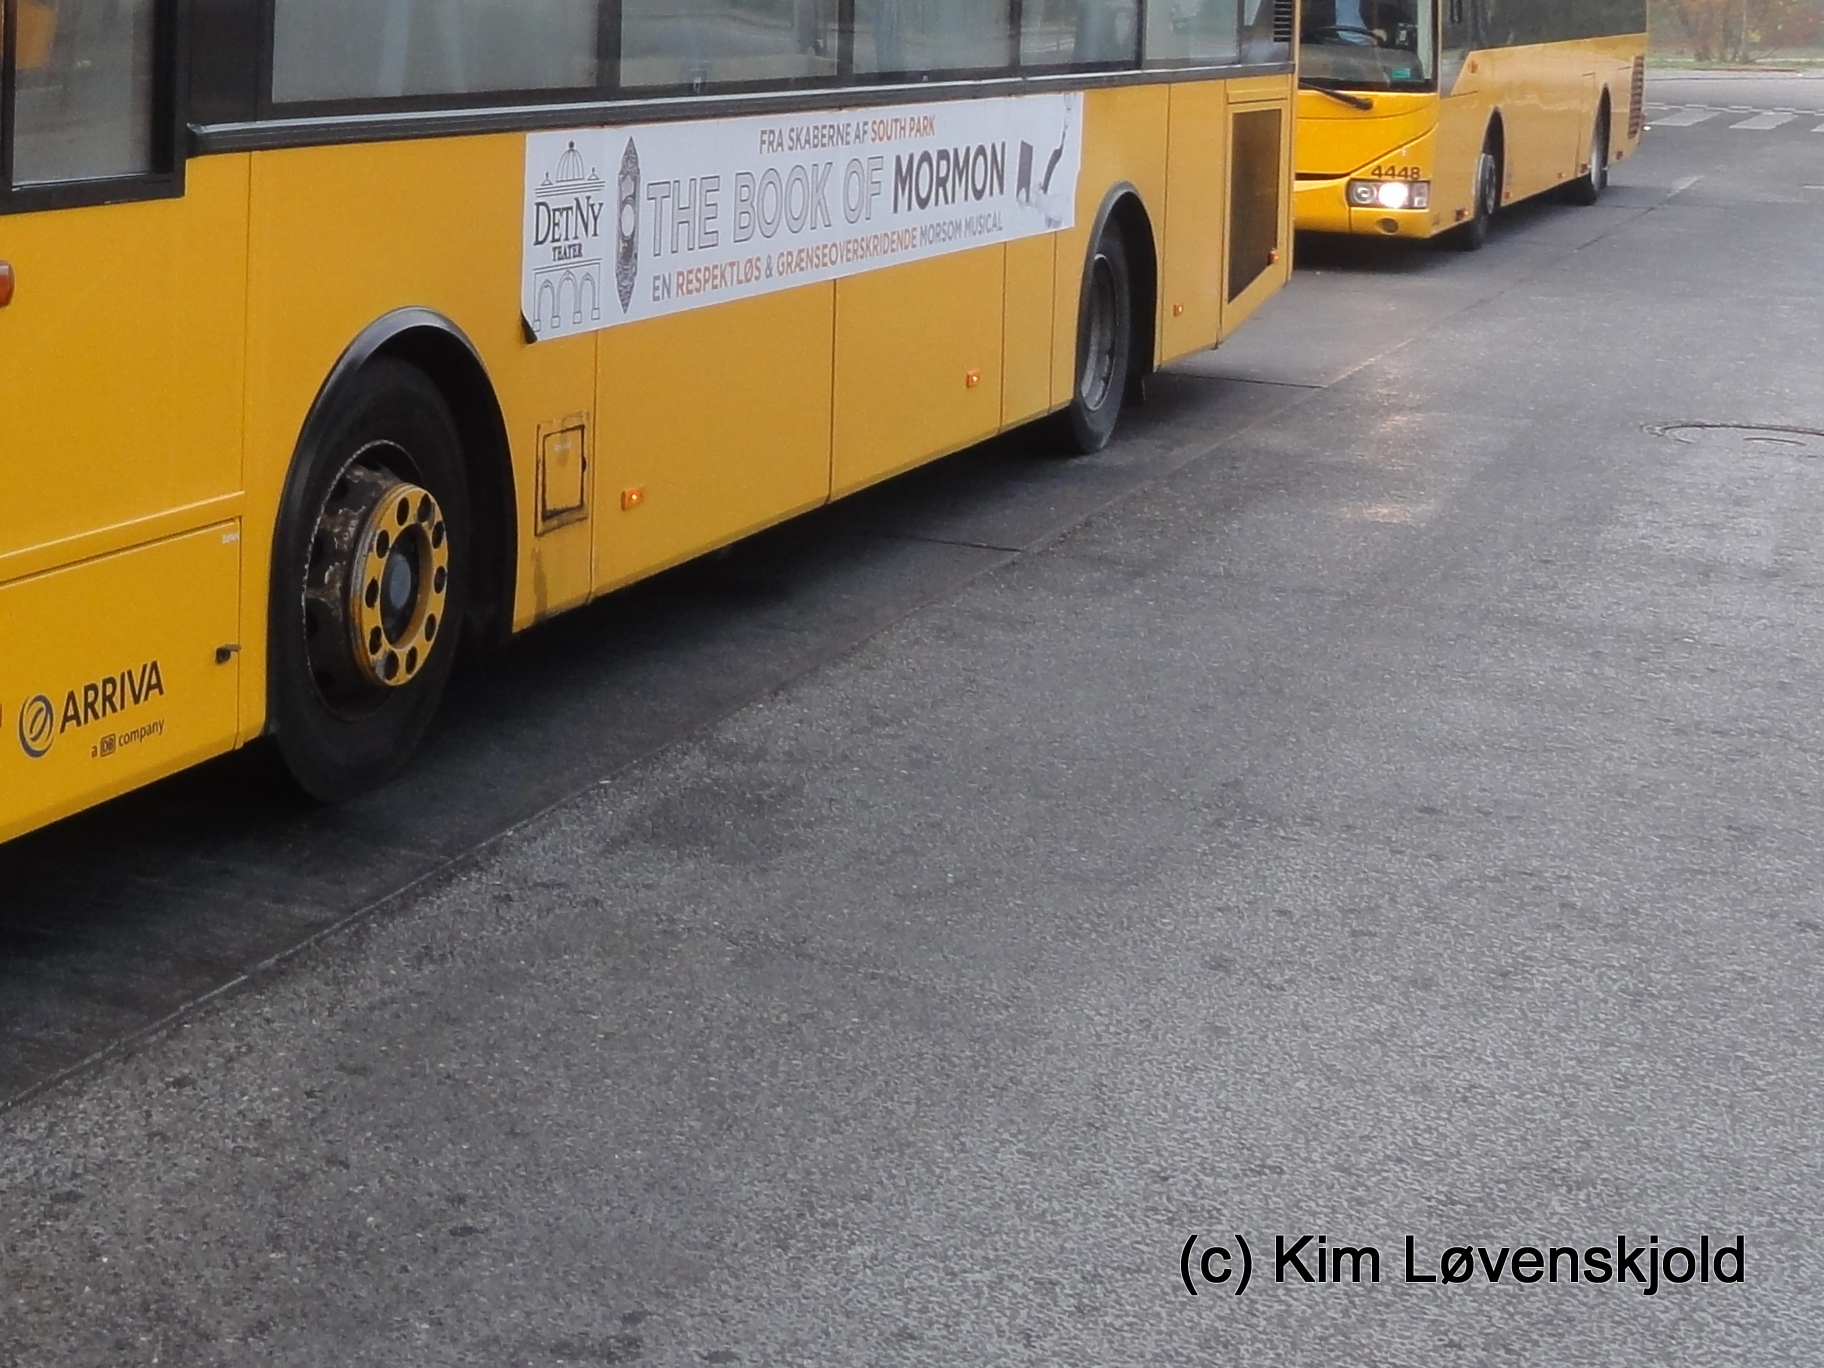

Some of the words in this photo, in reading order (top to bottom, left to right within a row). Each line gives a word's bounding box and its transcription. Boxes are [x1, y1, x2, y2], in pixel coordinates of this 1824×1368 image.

[759, 129, 784, 154] FRA
[787, 122, 851, 152] SKABERNE
[853, 120, 869, 145] AF
[870, 116, 907, 143] SOUTH
[908, 114, 936, 138] PARK
[1371, 164, 1421, 180] 4448
[646, 175, 720, 257] THE
[733, 161, 833, 243] BOOK
[842, 155, 884, 224] OF
[892, 141, 1006, 214] MORMON
[552, 243, 583, 262] TEATER
[652, 275, 672, 302] EN
[676, 256, 762, 297] RESPEKTLØS
[764, 254, 773, 279] &
[777, 227, 917, 276] GRÆNSEOVERSKRIDENDE
[919, 218, 962, 246] MORSOM
[964, 212, 1004, 239] MUSICAL
[60, 660, 164, 734] ARRIVA
[91, 745, 98, 758] a
[100, 734, 116, 757] DB
[118, 719, 165, 747] company
